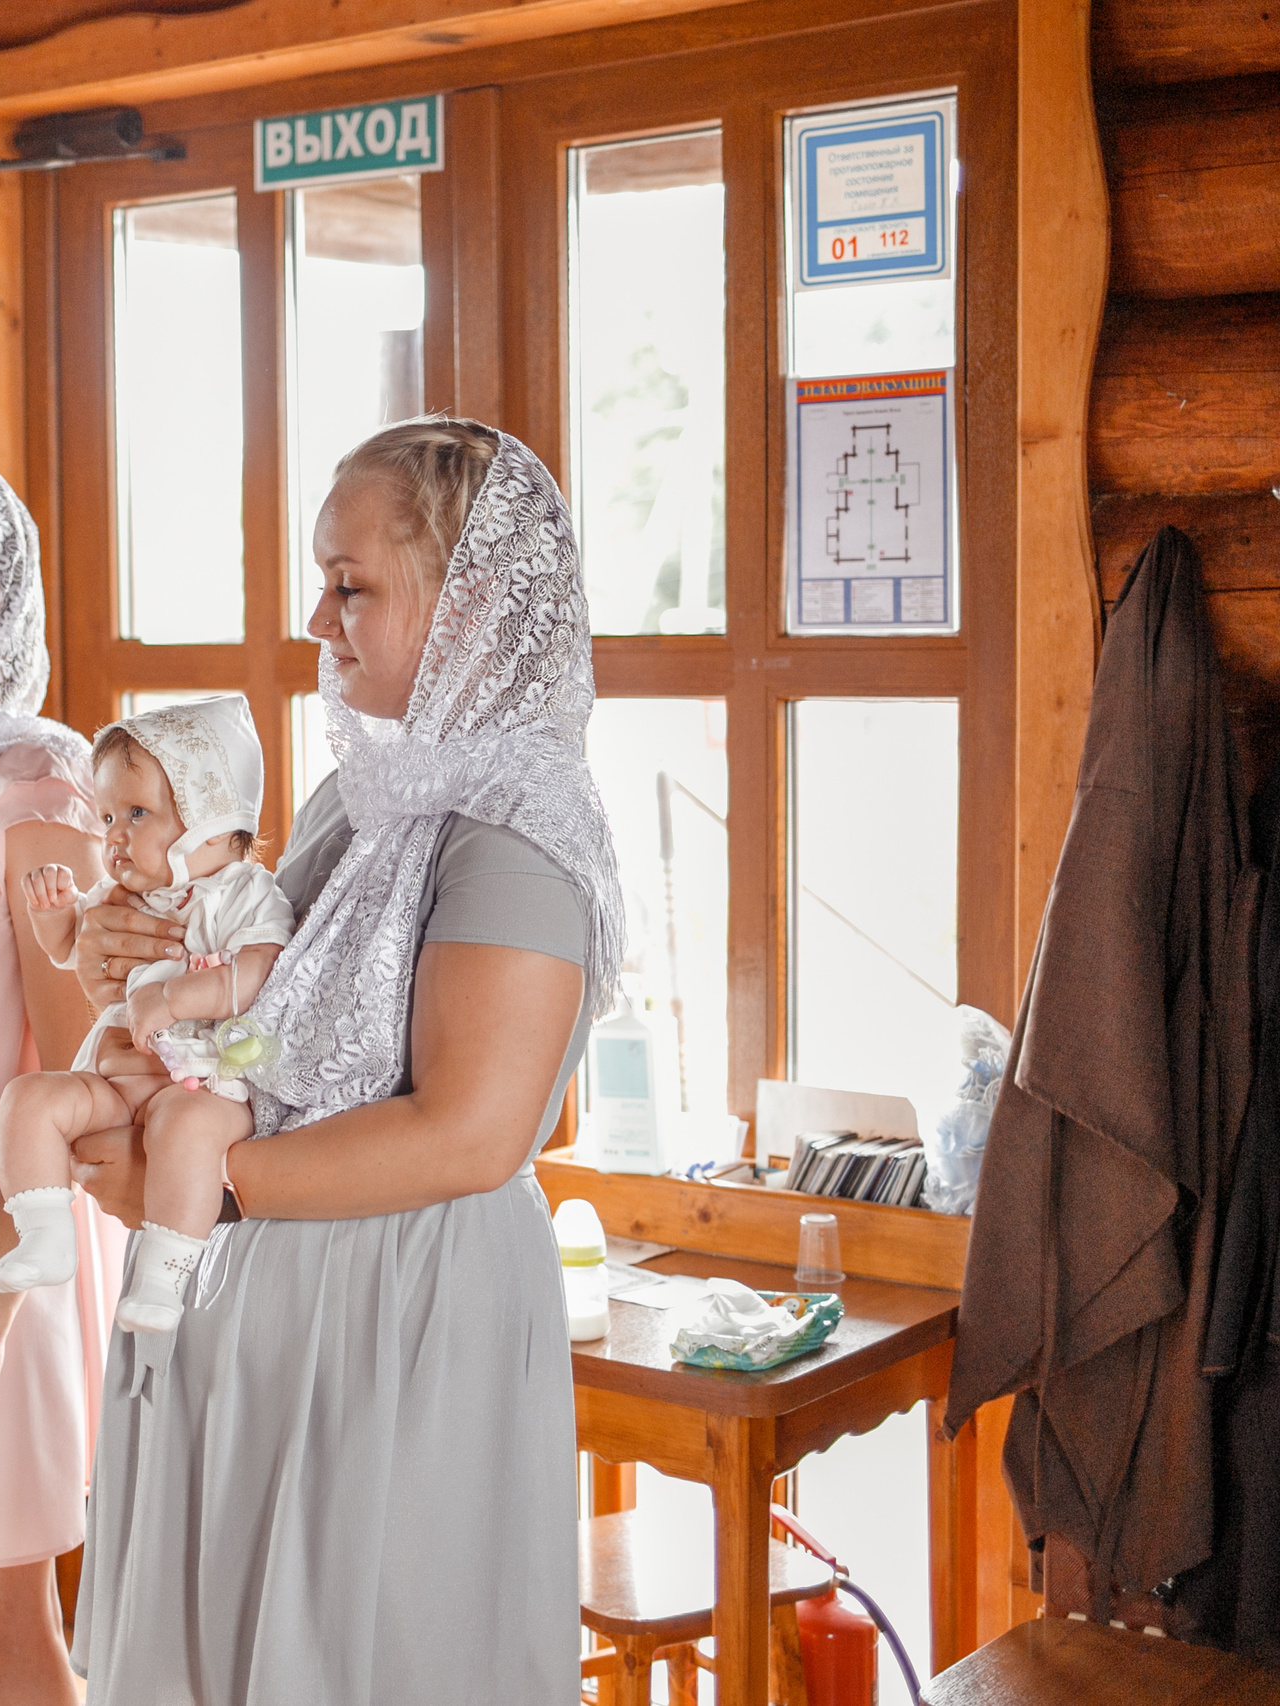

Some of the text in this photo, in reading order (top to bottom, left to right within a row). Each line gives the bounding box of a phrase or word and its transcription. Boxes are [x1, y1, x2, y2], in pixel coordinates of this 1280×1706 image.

[265, 103, 431, 168] ВЫХОД
[828, 145, 914, 163] Ответственный за
[829, 158, 913, 176] противопожарное
[845, 174, 894, 186] состояние
[832, 236, 857, 260] 01
[880, 229, 909, 247] 112
[804, 376, 942, 398] ПЛАН ЭВАКУАЦИИ
